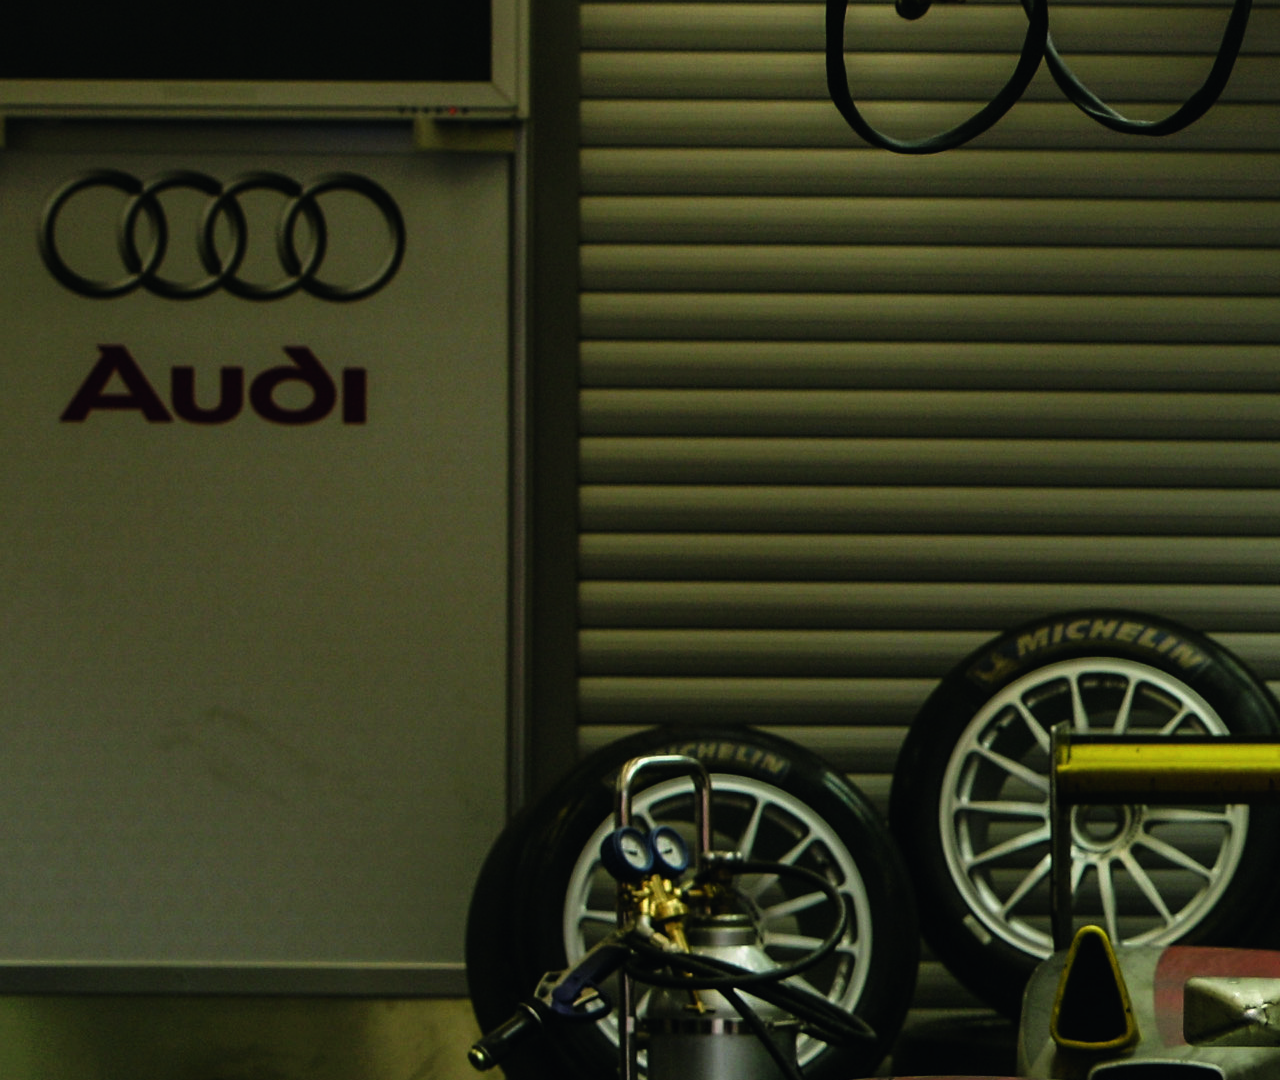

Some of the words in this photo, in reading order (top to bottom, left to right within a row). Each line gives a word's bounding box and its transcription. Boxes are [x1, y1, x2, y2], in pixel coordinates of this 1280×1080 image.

[59, 344, 367, 425] Audi
[1016, 618, 1207, 669] MICHELIN
[656, 742, 787, 774] ICHELIN
